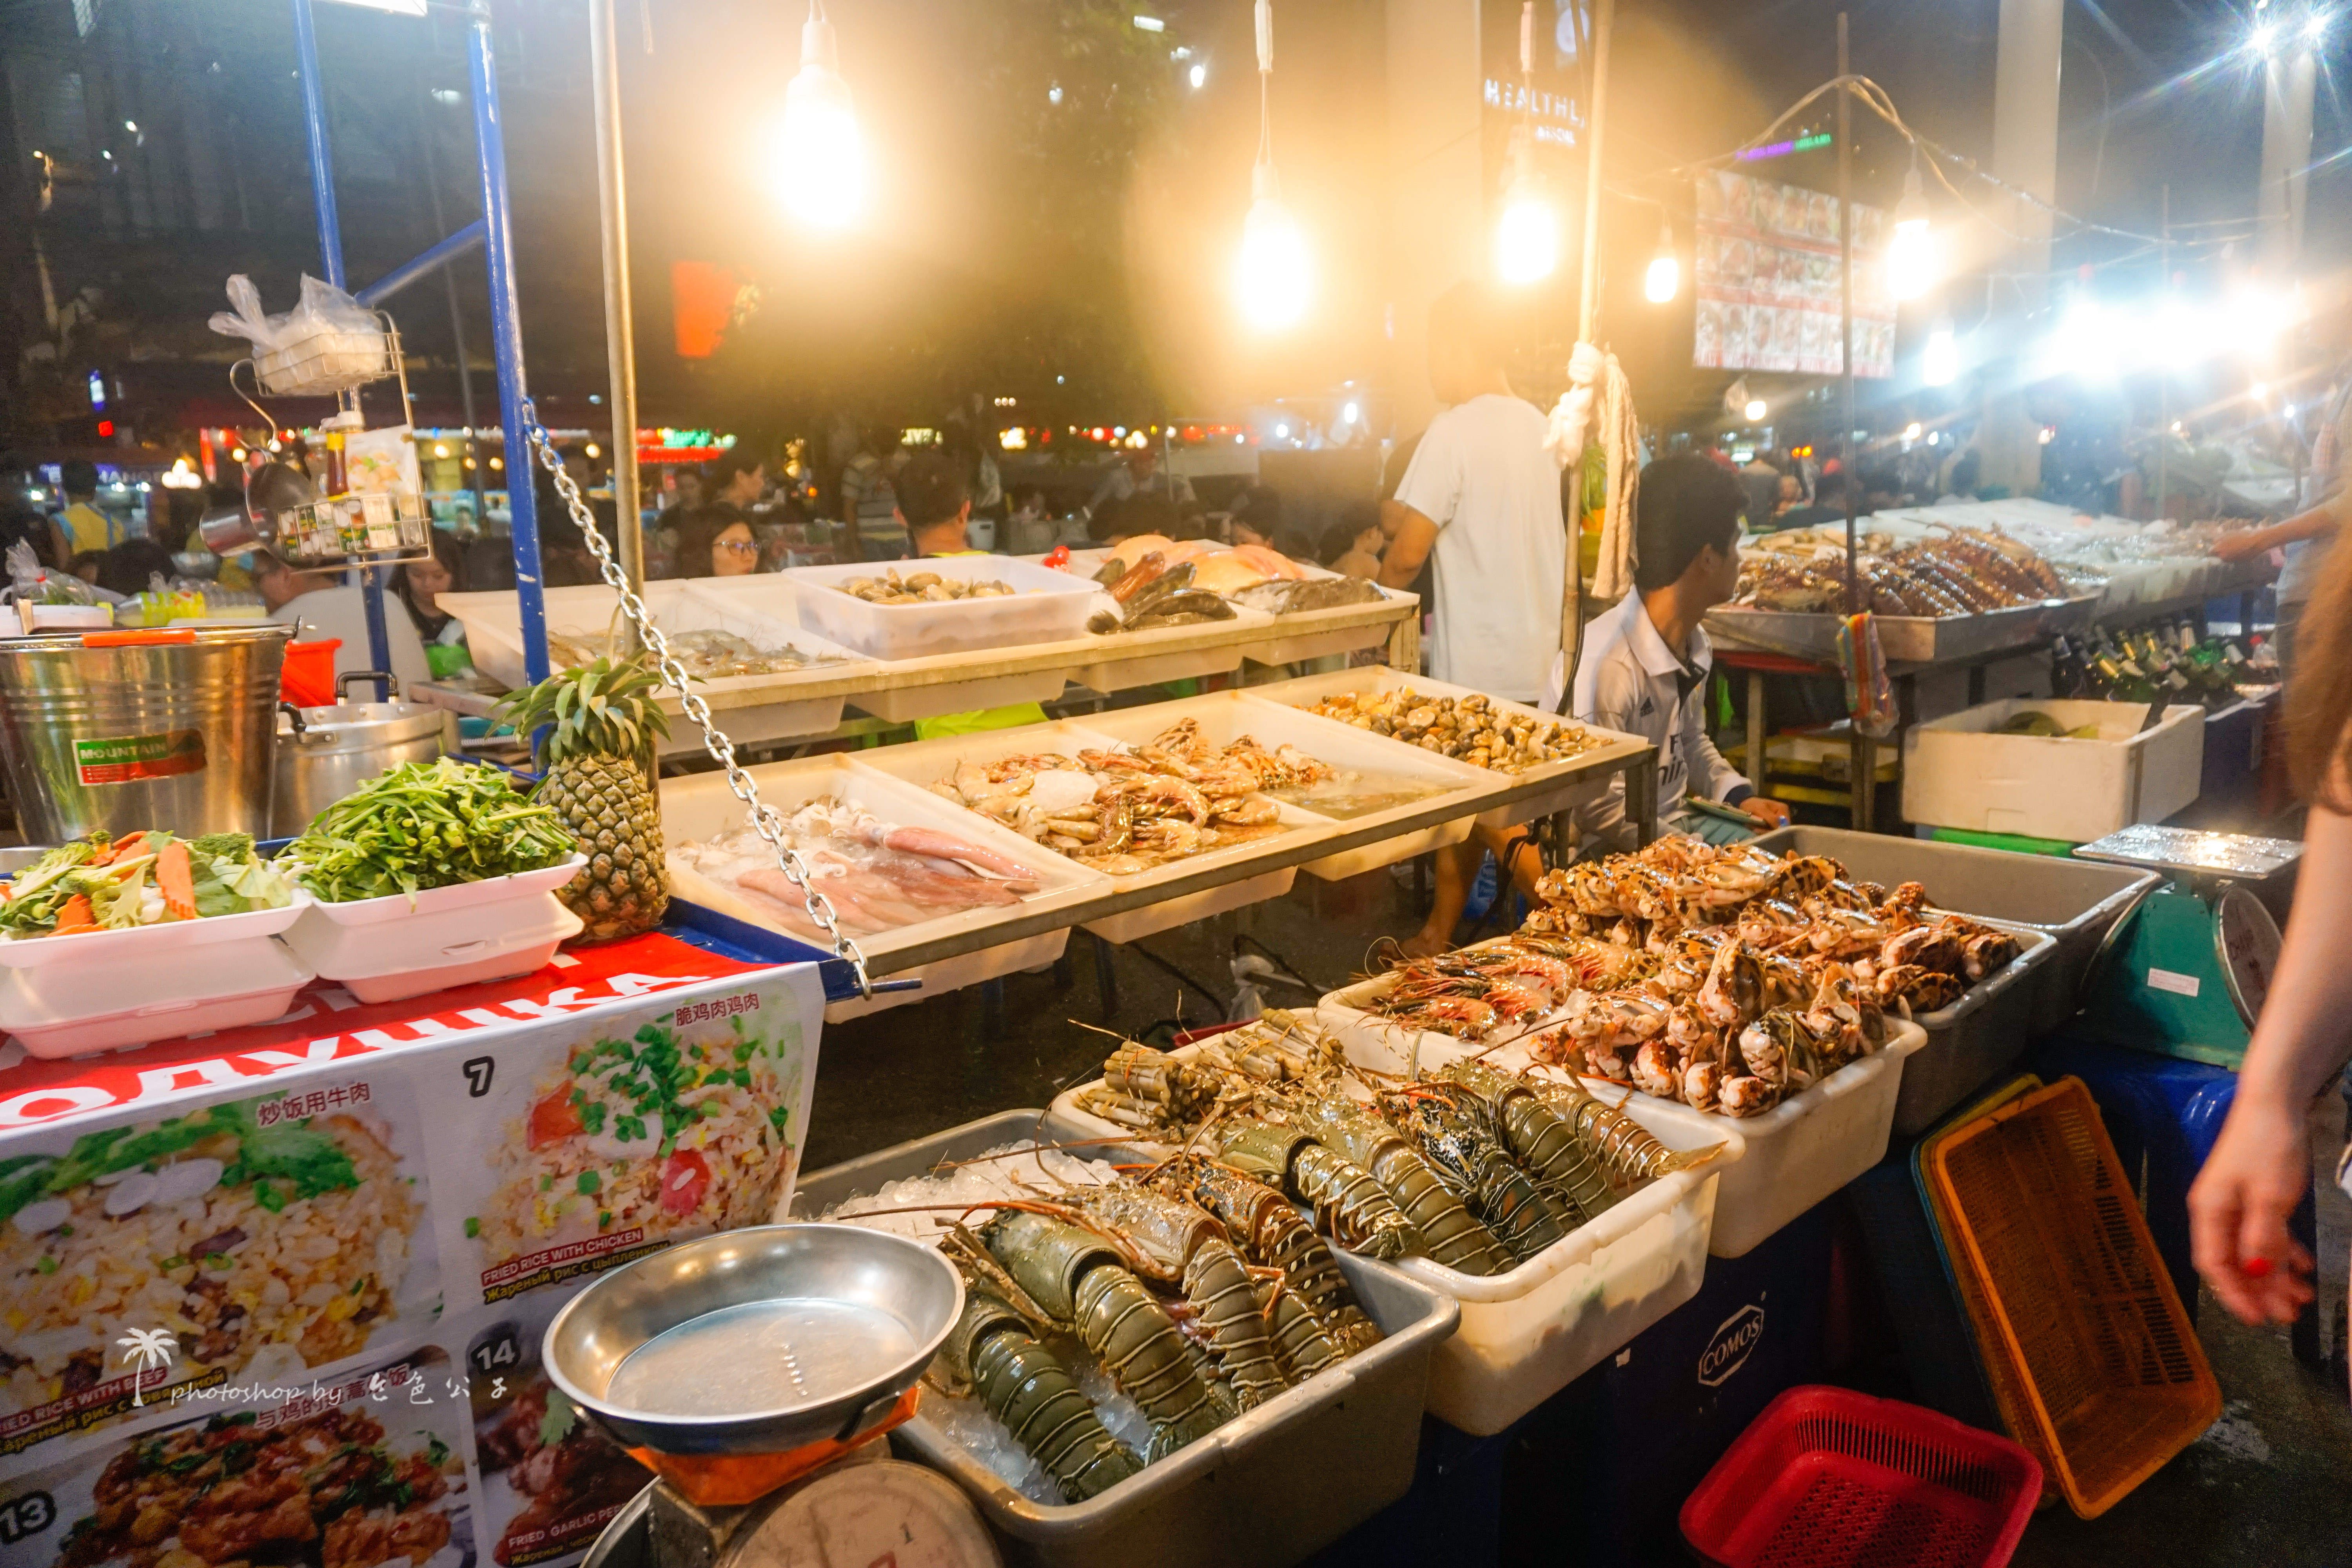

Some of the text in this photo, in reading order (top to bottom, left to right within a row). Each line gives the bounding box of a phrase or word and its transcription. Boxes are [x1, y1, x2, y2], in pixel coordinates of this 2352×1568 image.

[1484, 78, 1585, 129] HEALTHL
[676, 992, 759, 1030] 脆鸡肉鸡肉
[463, 1056, 495, 1098] 7
[258, 1082, 370, 1126] 炒饭用牛肉
[483, 1230, 642, 1285] FRIED RICE WITH CHICKEN
[485, 1270, 550, 1302] Жареный
[555, 1266, 579, 1282] рис
[477, 1338, 515, 1370] 14
[0, 1413, 30, 1432] IED
[33, 1399, 74, 1420] RICE
[79, 1382, 120, 1404] WITH
[0, 1497, 48, 1536] 13
[509, 1503, 626, 1548] FRIED GARLIC PEP
